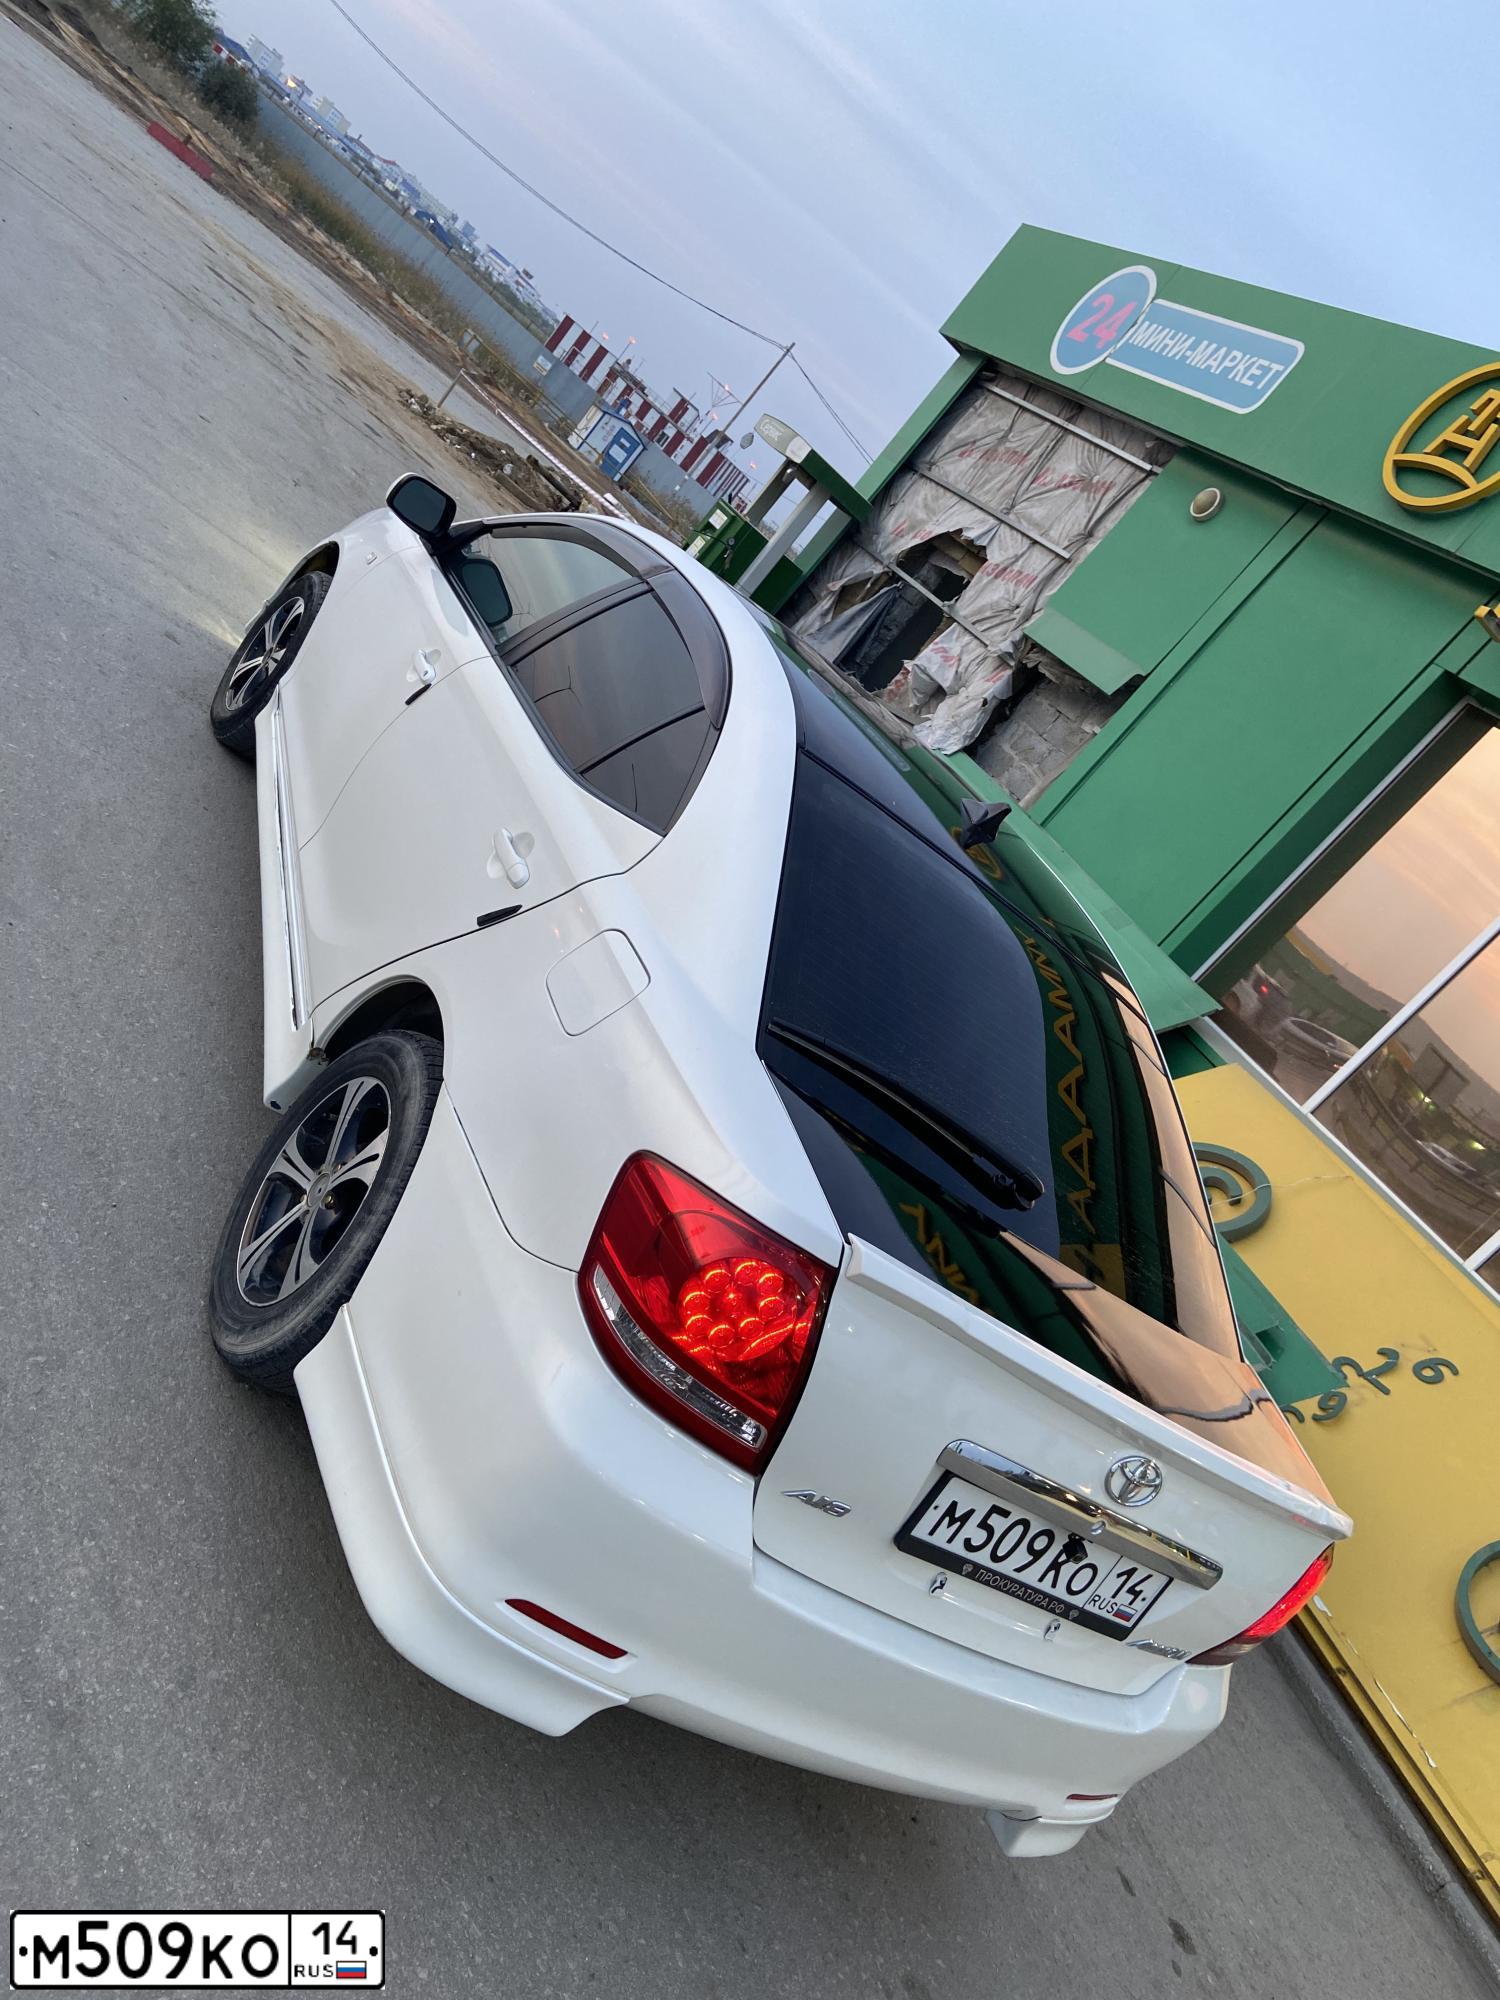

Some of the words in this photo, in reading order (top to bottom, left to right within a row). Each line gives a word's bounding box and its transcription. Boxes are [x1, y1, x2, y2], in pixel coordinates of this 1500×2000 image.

[1067, 292, 1138, 349] 24
[1128, 320, 1285, 390] МИНИ-МАРКЕТ
[974, 1568, 1049, 1611] ПРОКУРАТУРА
[1047, 1599, 1065, 1615] РФ
[1088, 1594, 1119, 1614] RUS
[1111, 1566, 1153, 1606] 14
